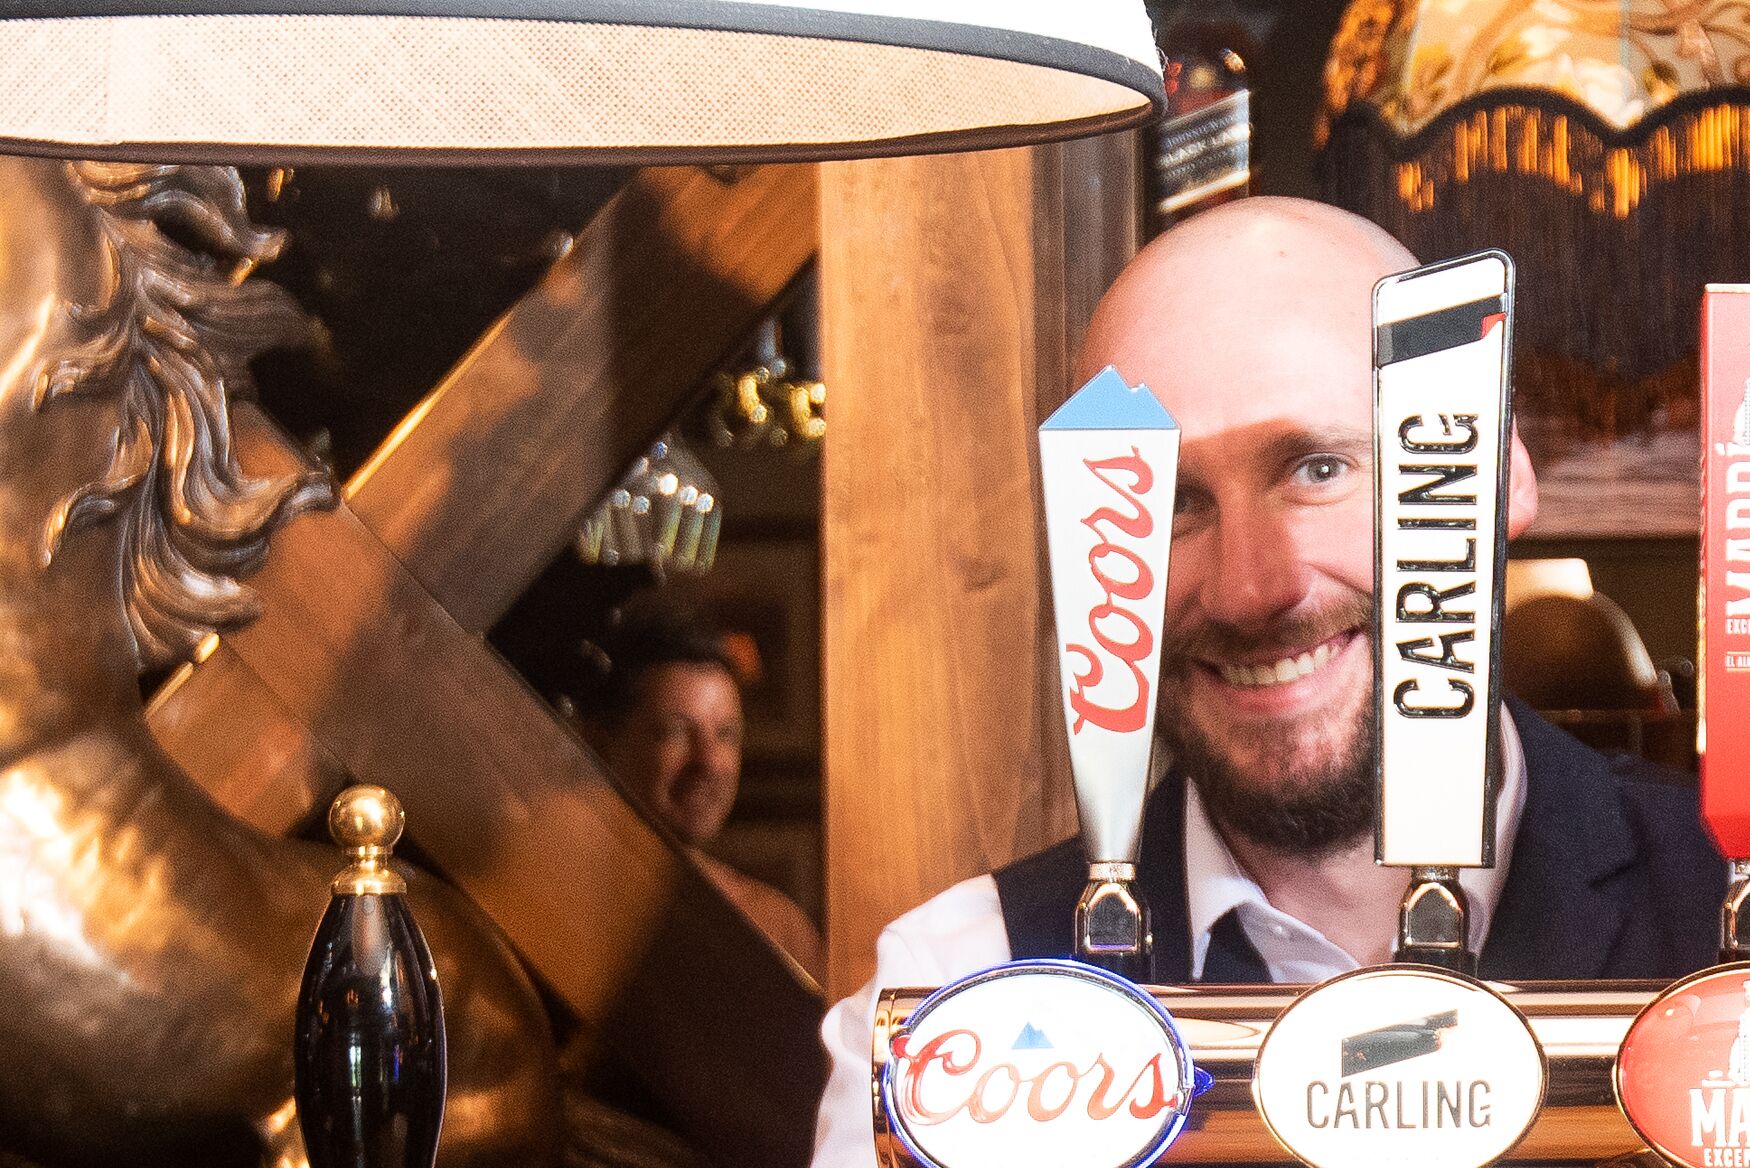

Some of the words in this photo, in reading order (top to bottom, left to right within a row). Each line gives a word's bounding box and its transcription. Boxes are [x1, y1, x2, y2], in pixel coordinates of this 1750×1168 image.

[1066, 446, 1155, 736] Coors
[1393, 412, 1479, 718] CARLING
[892, 1028, 1181, 1127] Coors
[1306, 1079, 1492, 1130] CARLING
